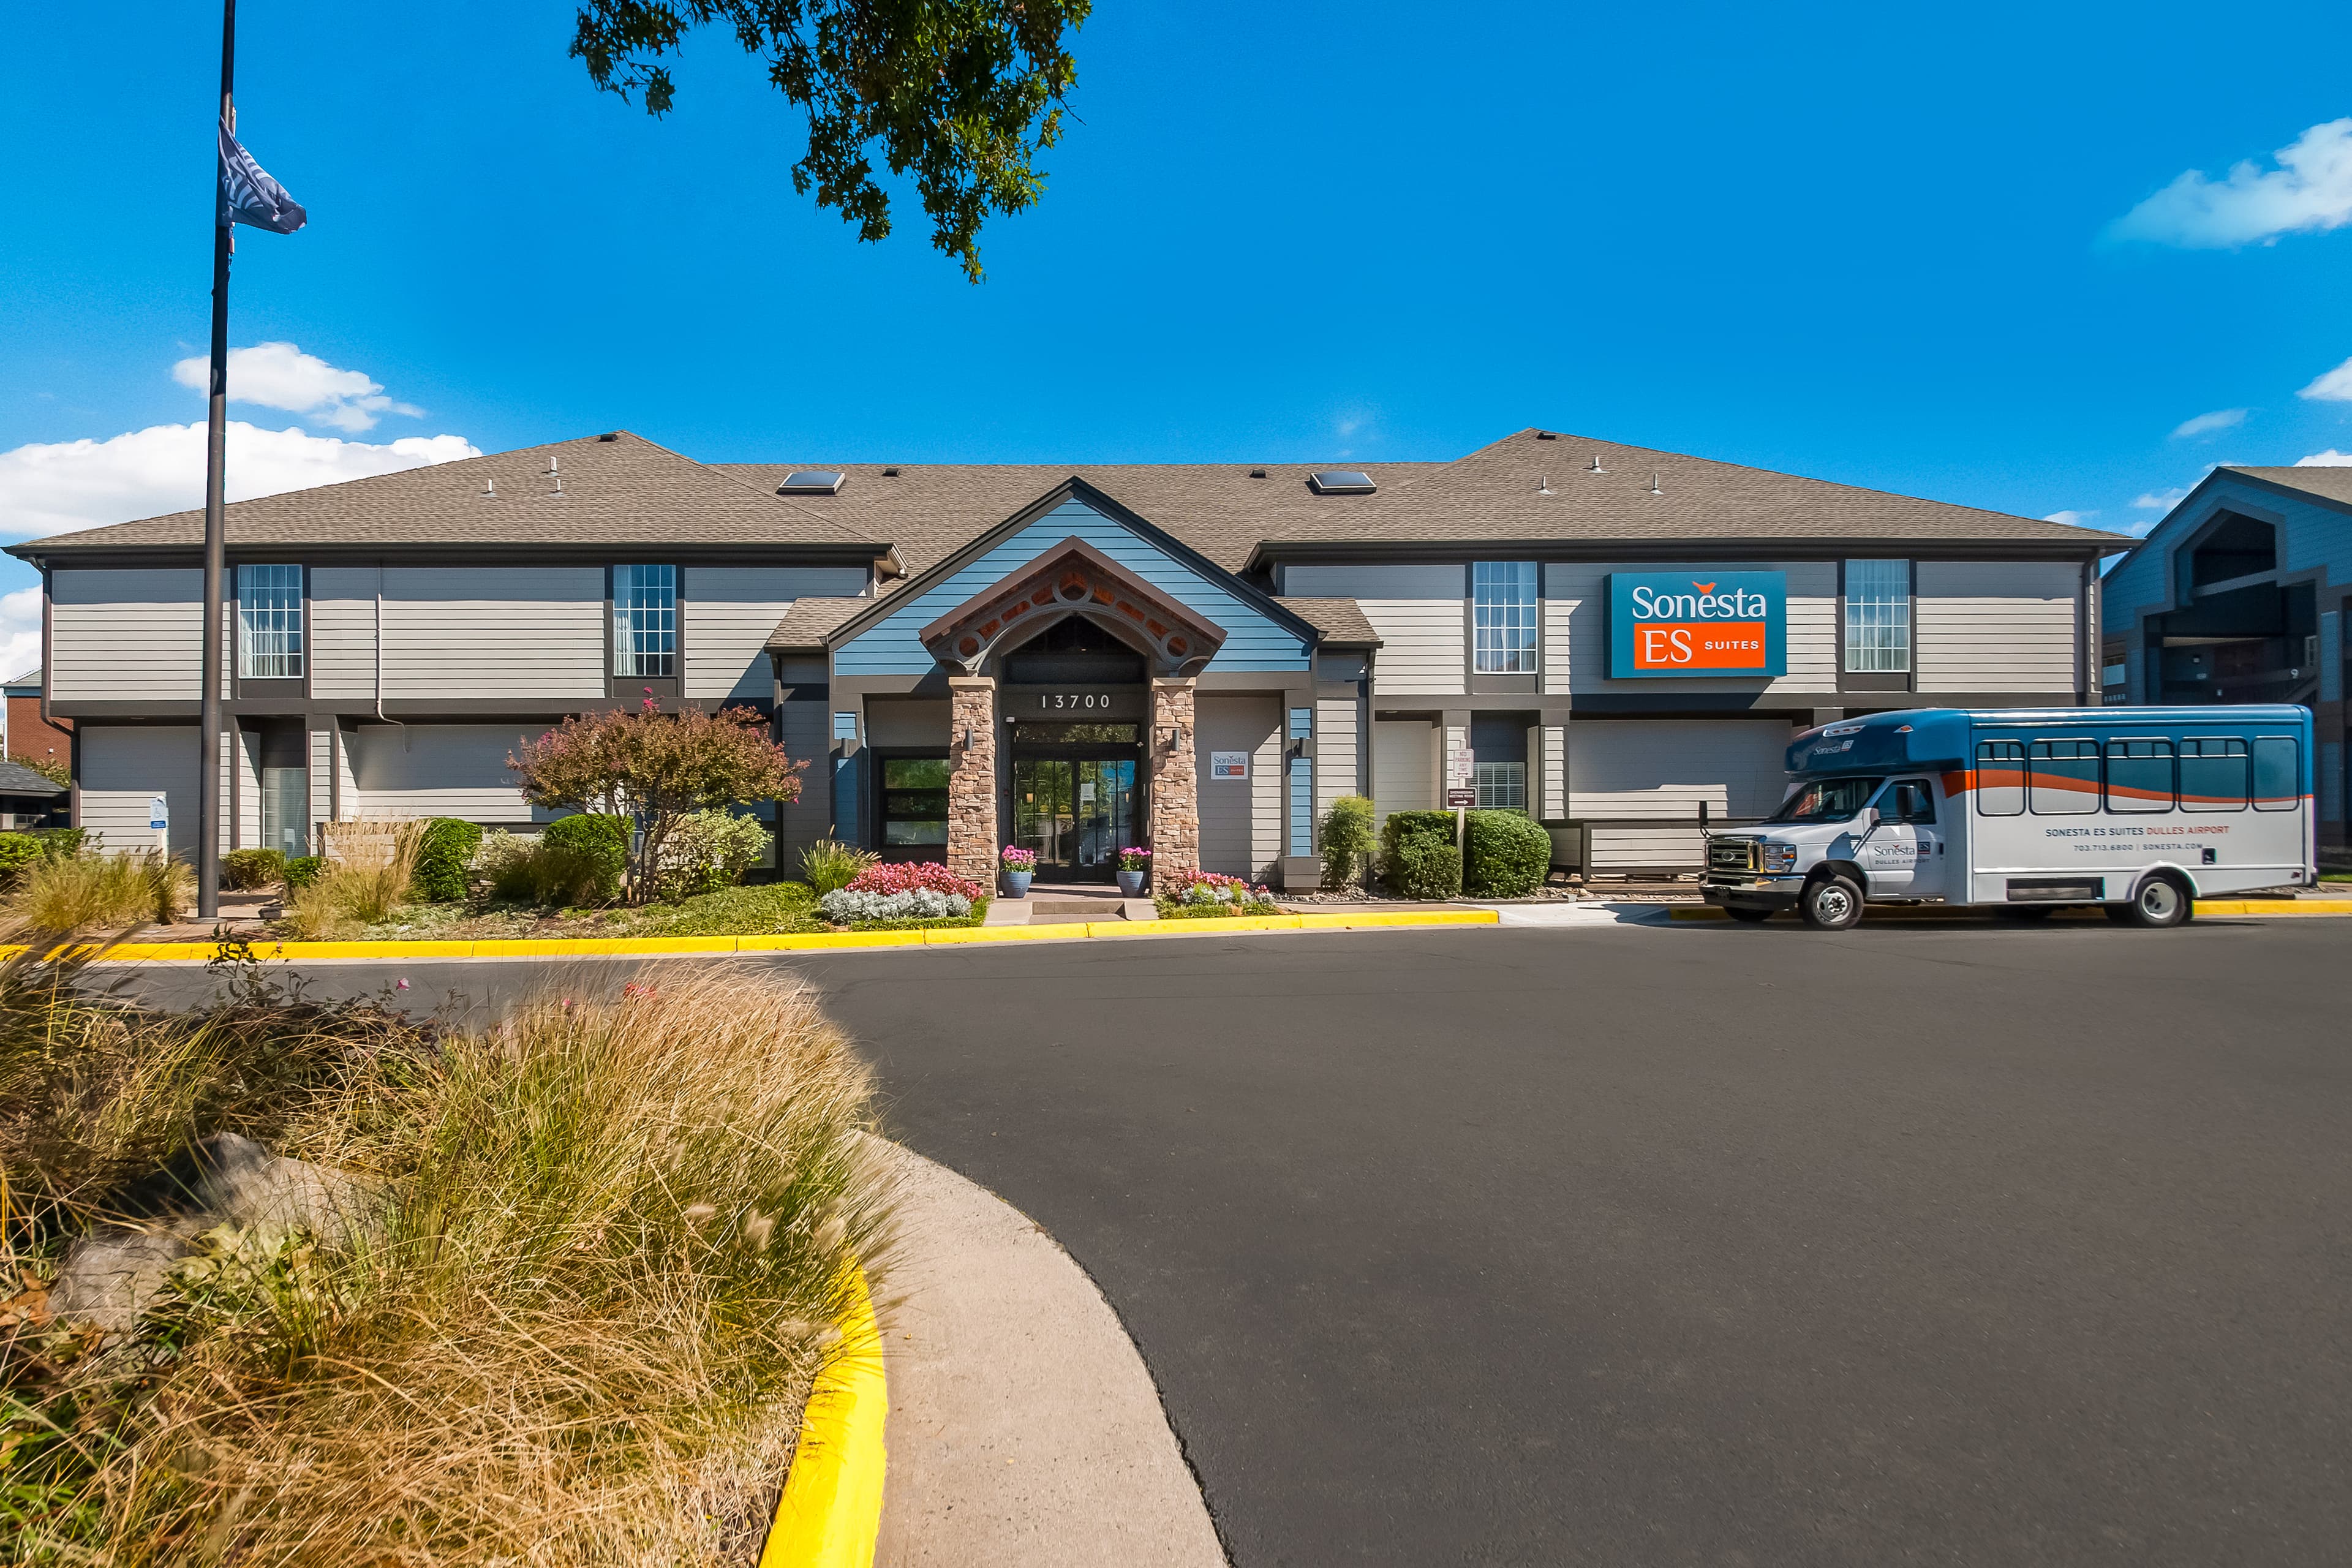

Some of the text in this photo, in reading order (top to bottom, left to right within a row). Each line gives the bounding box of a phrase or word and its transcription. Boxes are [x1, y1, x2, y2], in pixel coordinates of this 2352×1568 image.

[1632, 586, 1766, 619] Sonesta
[1642, 629, 1759, 663] ES SUITES
[1042, 695, 1109, 708] 13700
[1214, 756, 1246, 764] Sonesta
[1218, 766, 1229, 775] ES
[1874, 846, 1915, 856] Sonesta
